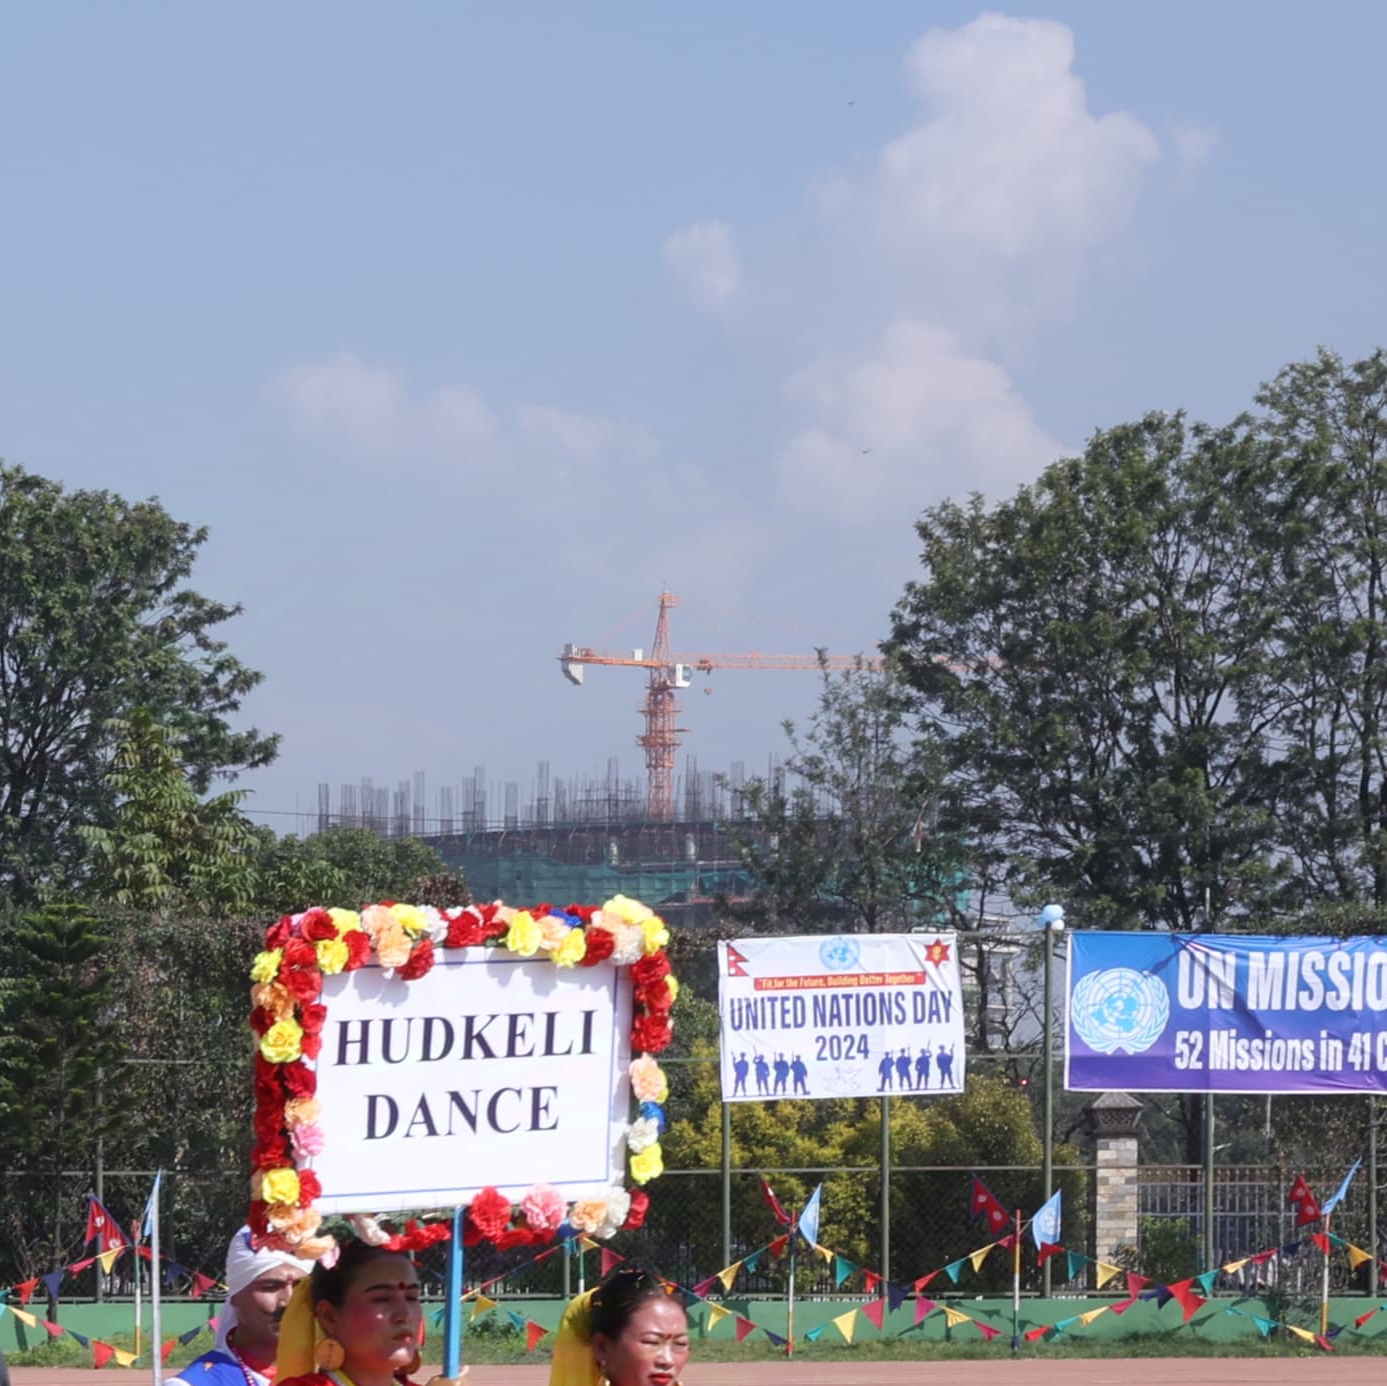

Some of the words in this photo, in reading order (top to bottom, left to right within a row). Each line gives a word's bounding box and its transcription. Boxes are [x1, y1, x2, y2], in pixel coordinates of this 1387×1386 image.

[1177, 949, 1236, 1010] UN
[1247, 950, 1387, 1012] MISSIO
[730, 995, 806, 1031] UNITED
[813, 991, 907, 1028] NATIONS
[913, 990, 953, 1025] DAY
[332, 1009, 598, 1066] HUDKELI
[815, 1034, 870, 1061] 2024
[1174, 1030, 1204, 1070] 52
[1209, 1029, 1315, 1072] Missions
[1319, 1030, 1344, 1072] in
[1347, 1031, 1372, 1072] 41
[362, 1085, 562, 1141] DANCE
